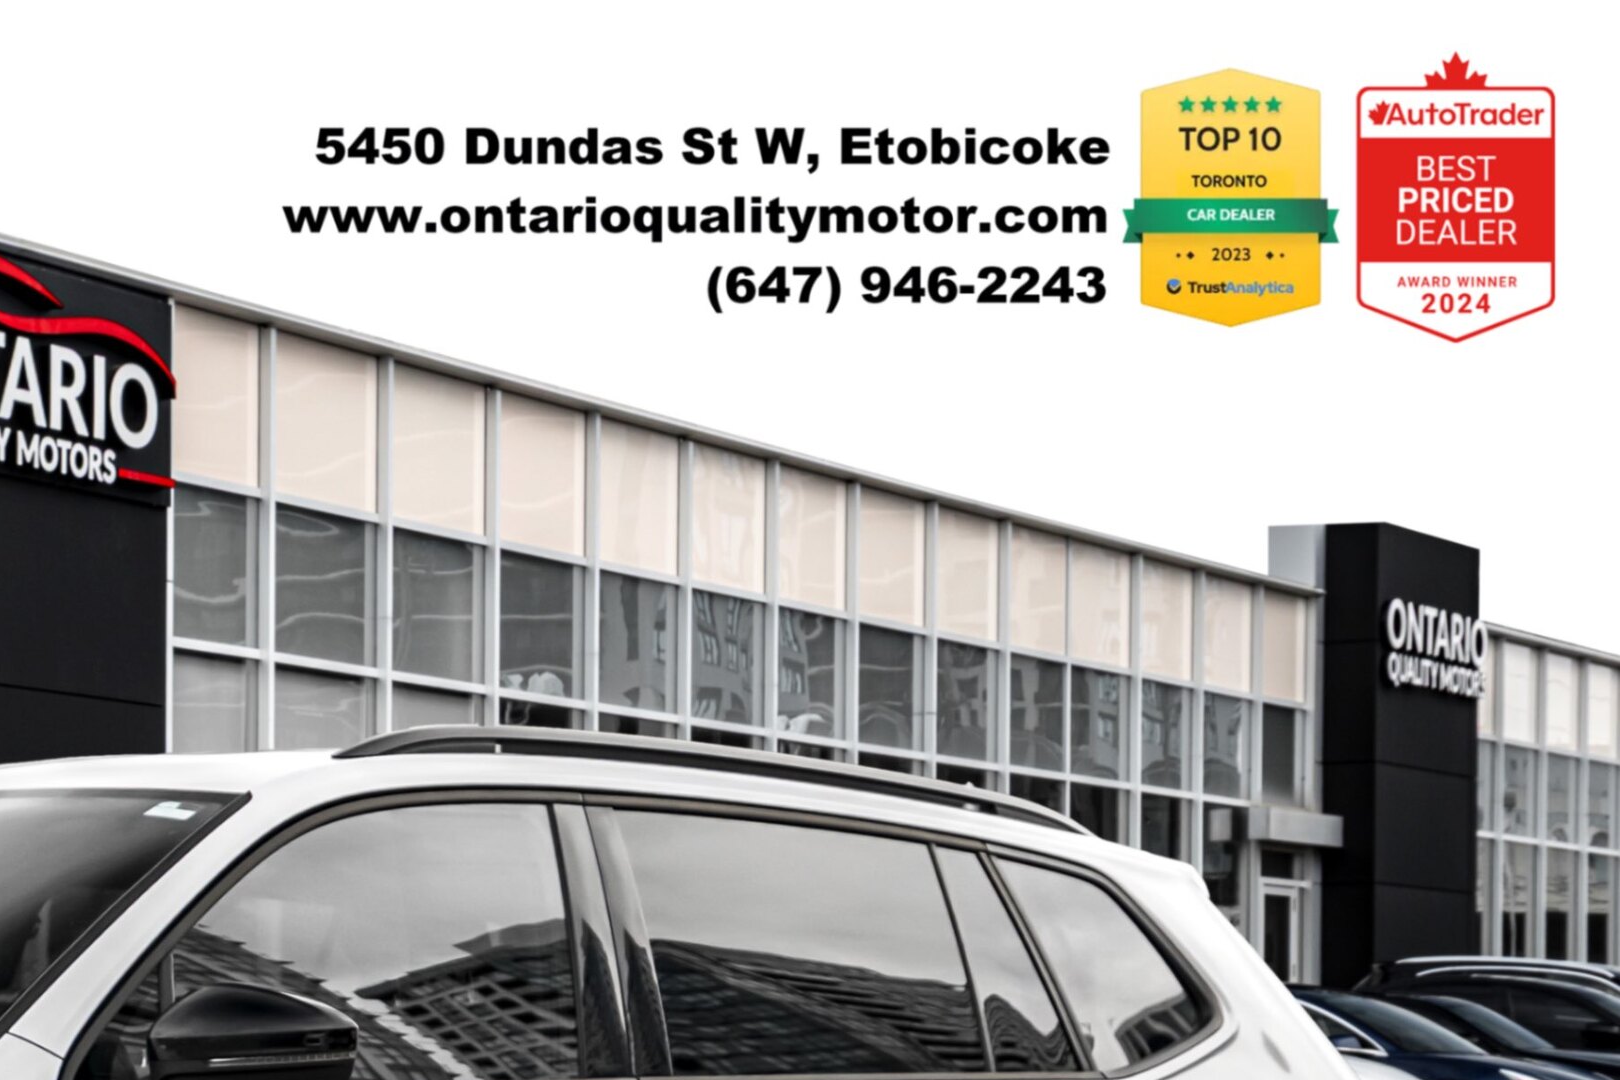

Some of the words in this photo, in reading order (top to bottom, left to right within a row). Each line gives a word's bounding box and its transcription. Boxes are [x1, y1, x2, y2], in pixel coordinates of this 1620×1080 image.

[16, 430, 117, 484] MOTORS
[1386, 598, 1488, 666] ONTARIO
[1387, 652, 1438, 687] QUALITY
